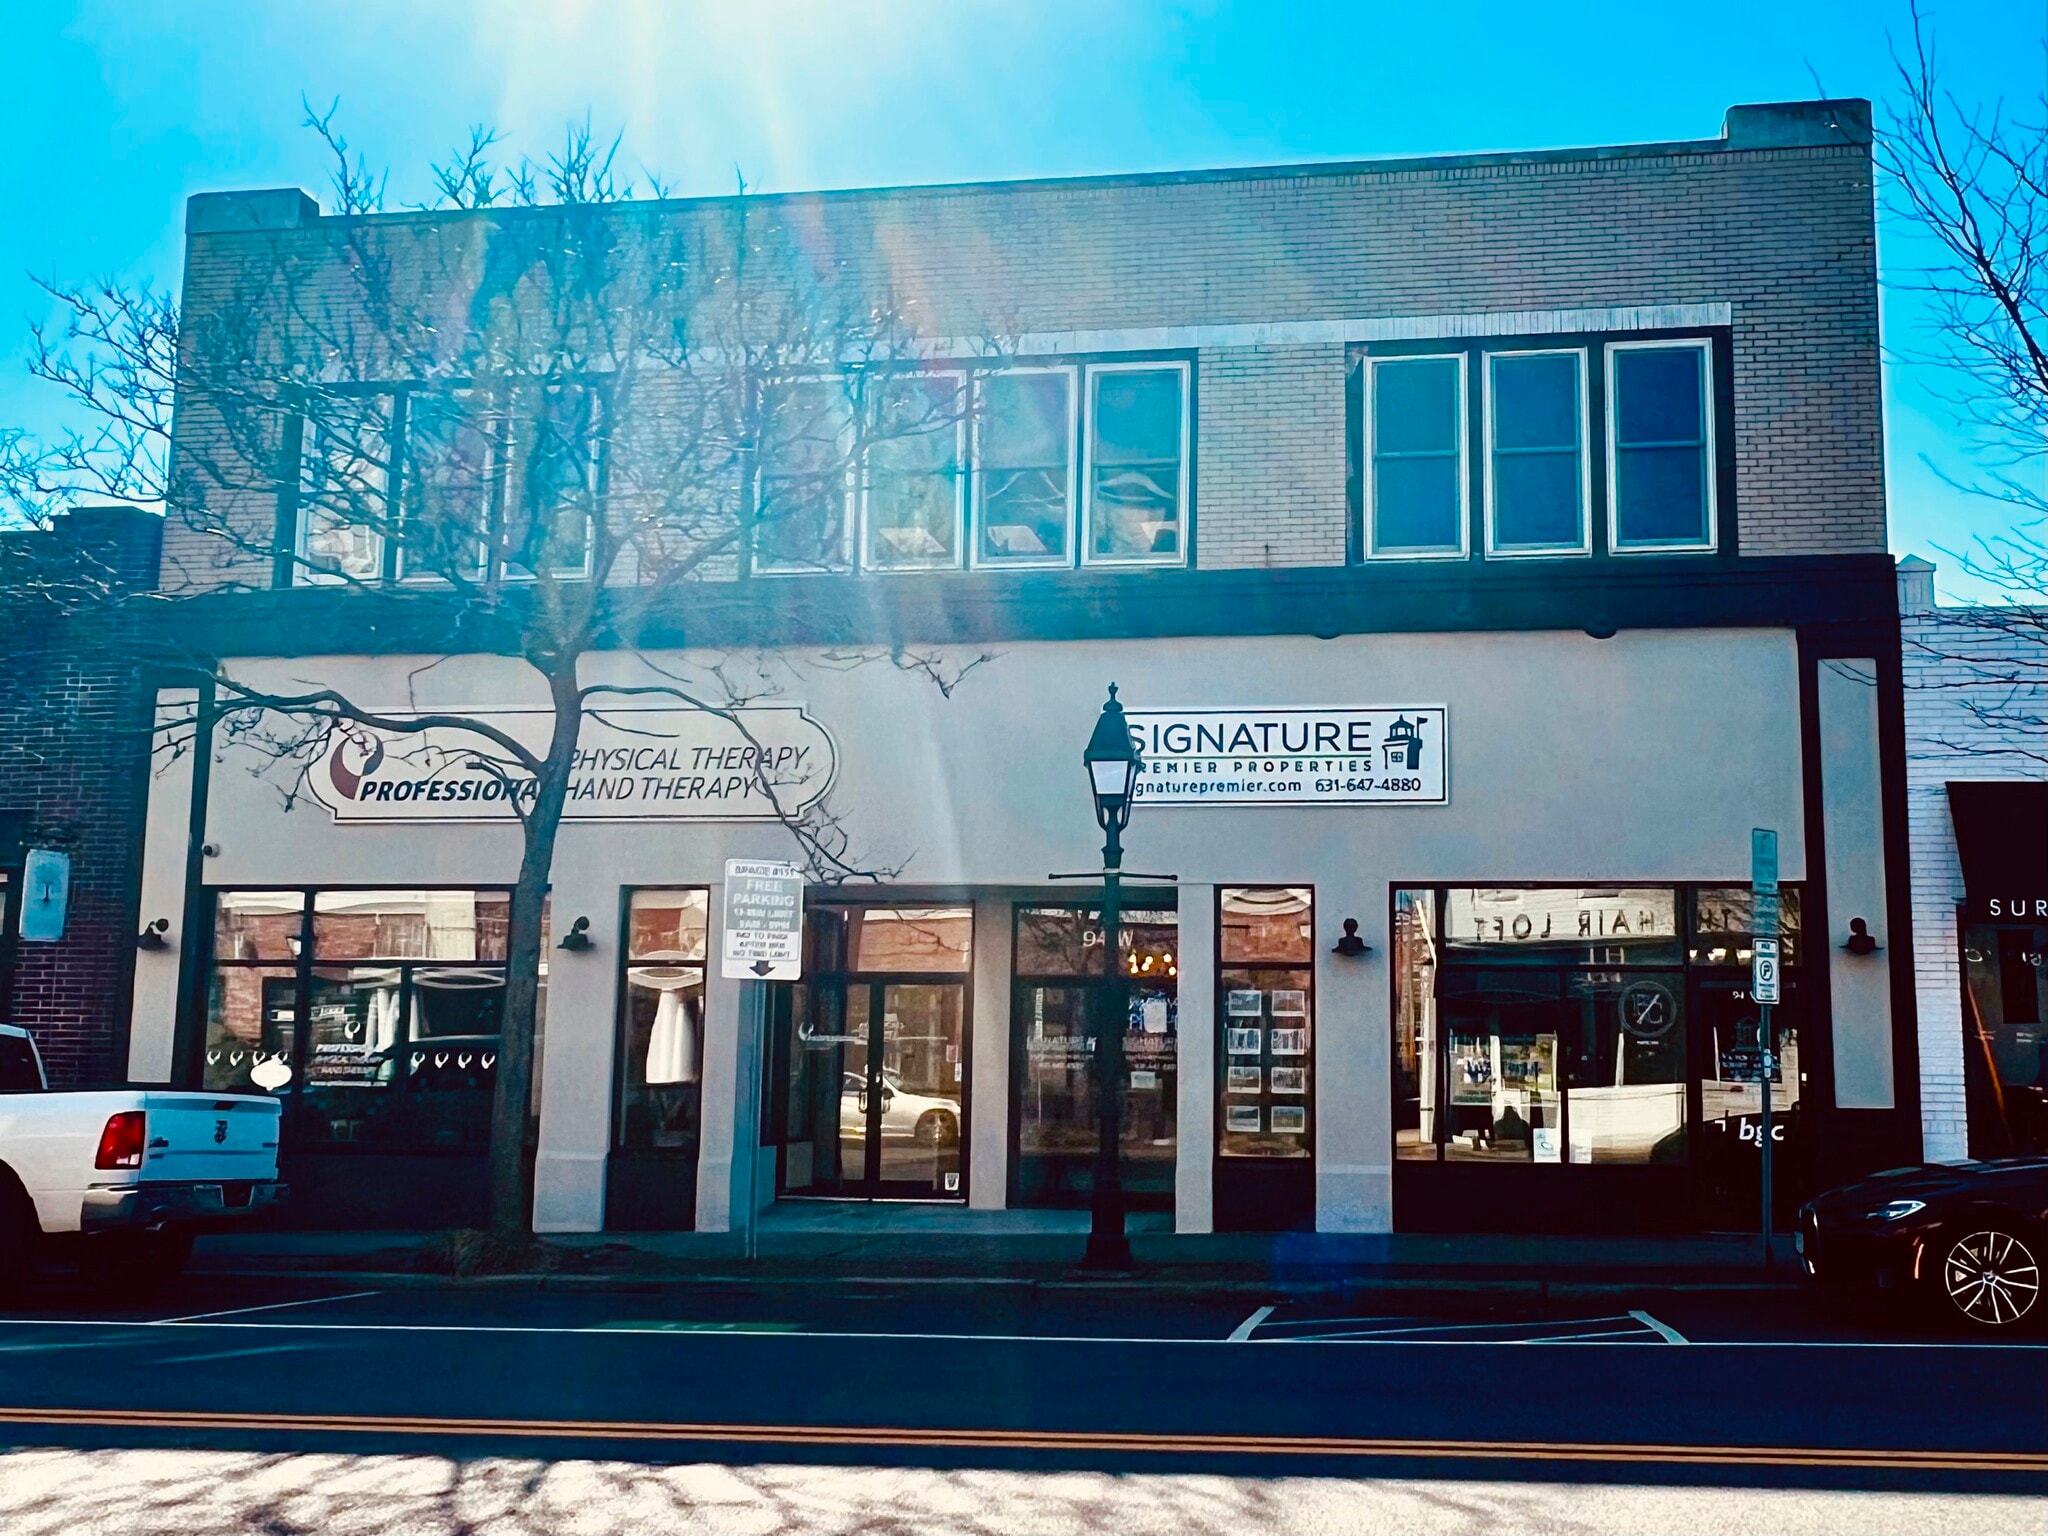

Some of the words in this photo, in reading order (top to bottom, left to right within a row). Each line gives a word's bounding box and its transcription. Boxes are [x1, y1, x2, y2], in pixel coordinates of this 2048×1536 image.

[691, 746, 810, 770] THERAPY
[1141, 761, 1217, 774] REMIER
[1233, 760, 1373, 773] PROPERTIES
[359, 779, 541, 802] PROFESSIONA
[641, 776, 759, 800] THERAPY
[1135, 778, 1302, 797] gnaturepremier.com
[1314, 777, 1422, 793] 631-647-4880
[746, 879, 783, 892] FREE
[733, 893, 795, 906] PARKING
